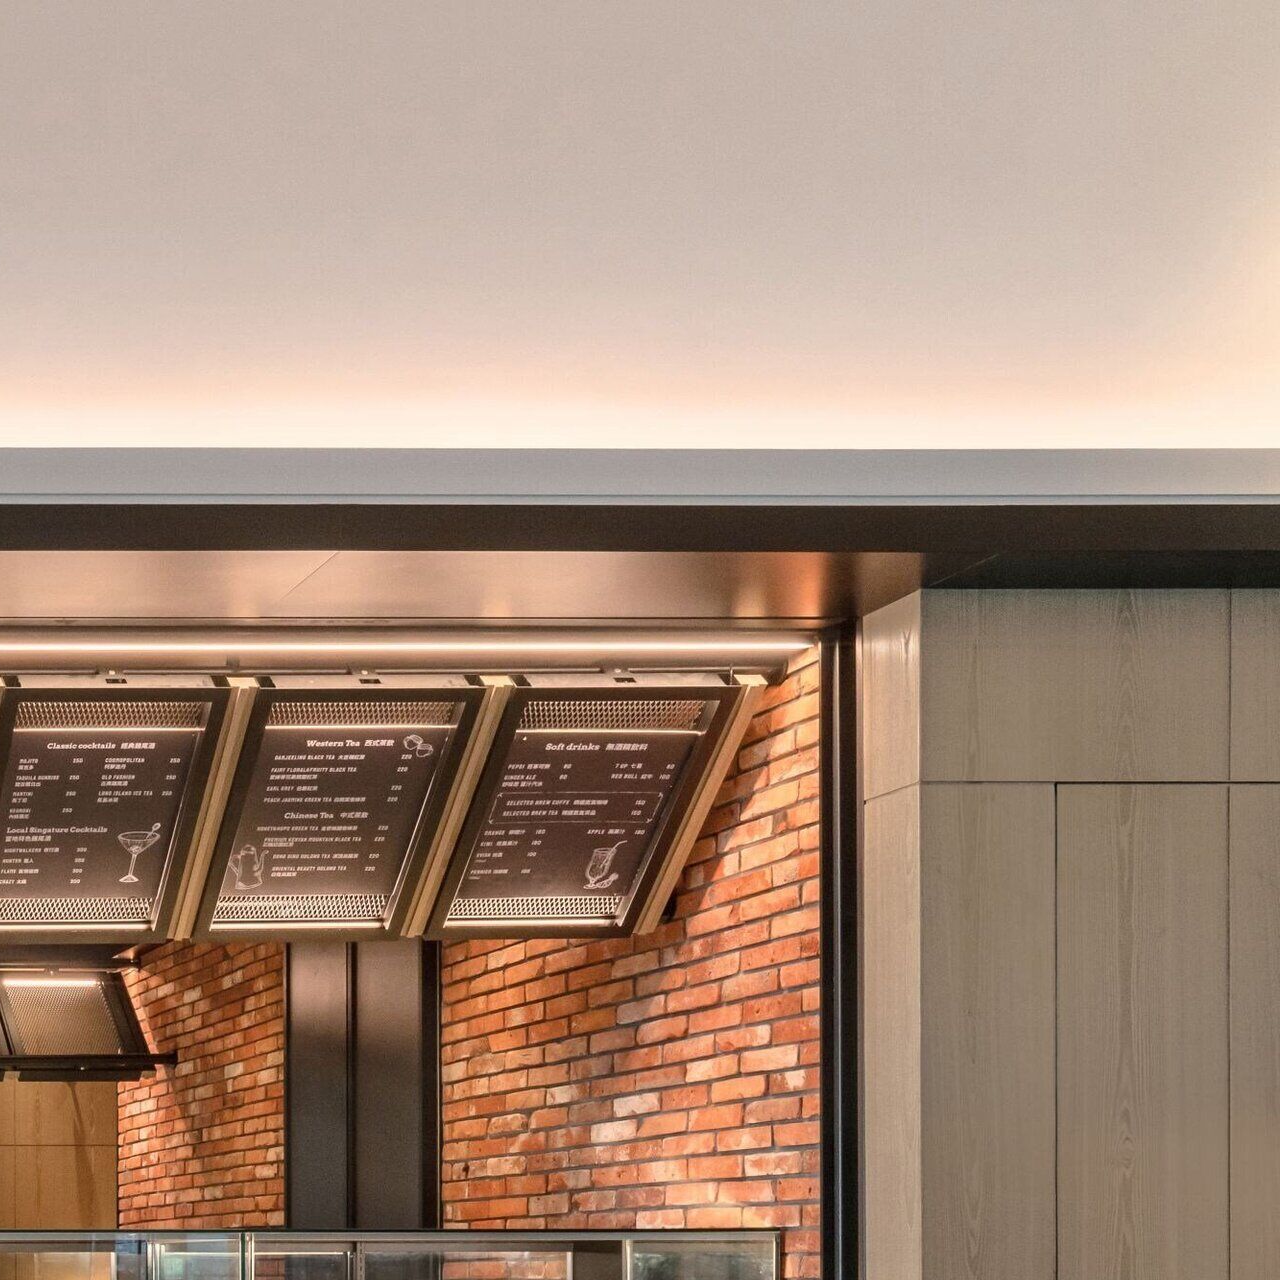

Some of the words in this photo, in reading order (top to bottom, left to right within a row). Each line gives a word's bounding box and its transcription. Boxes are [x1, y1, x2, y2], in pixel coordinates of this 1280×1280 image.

[47, 742, 77, 750] Classic
[78, 742, 116, 750] cocktails
[546, 743, 565, 751] Soft
[566, 743, 601, 751] drinks
